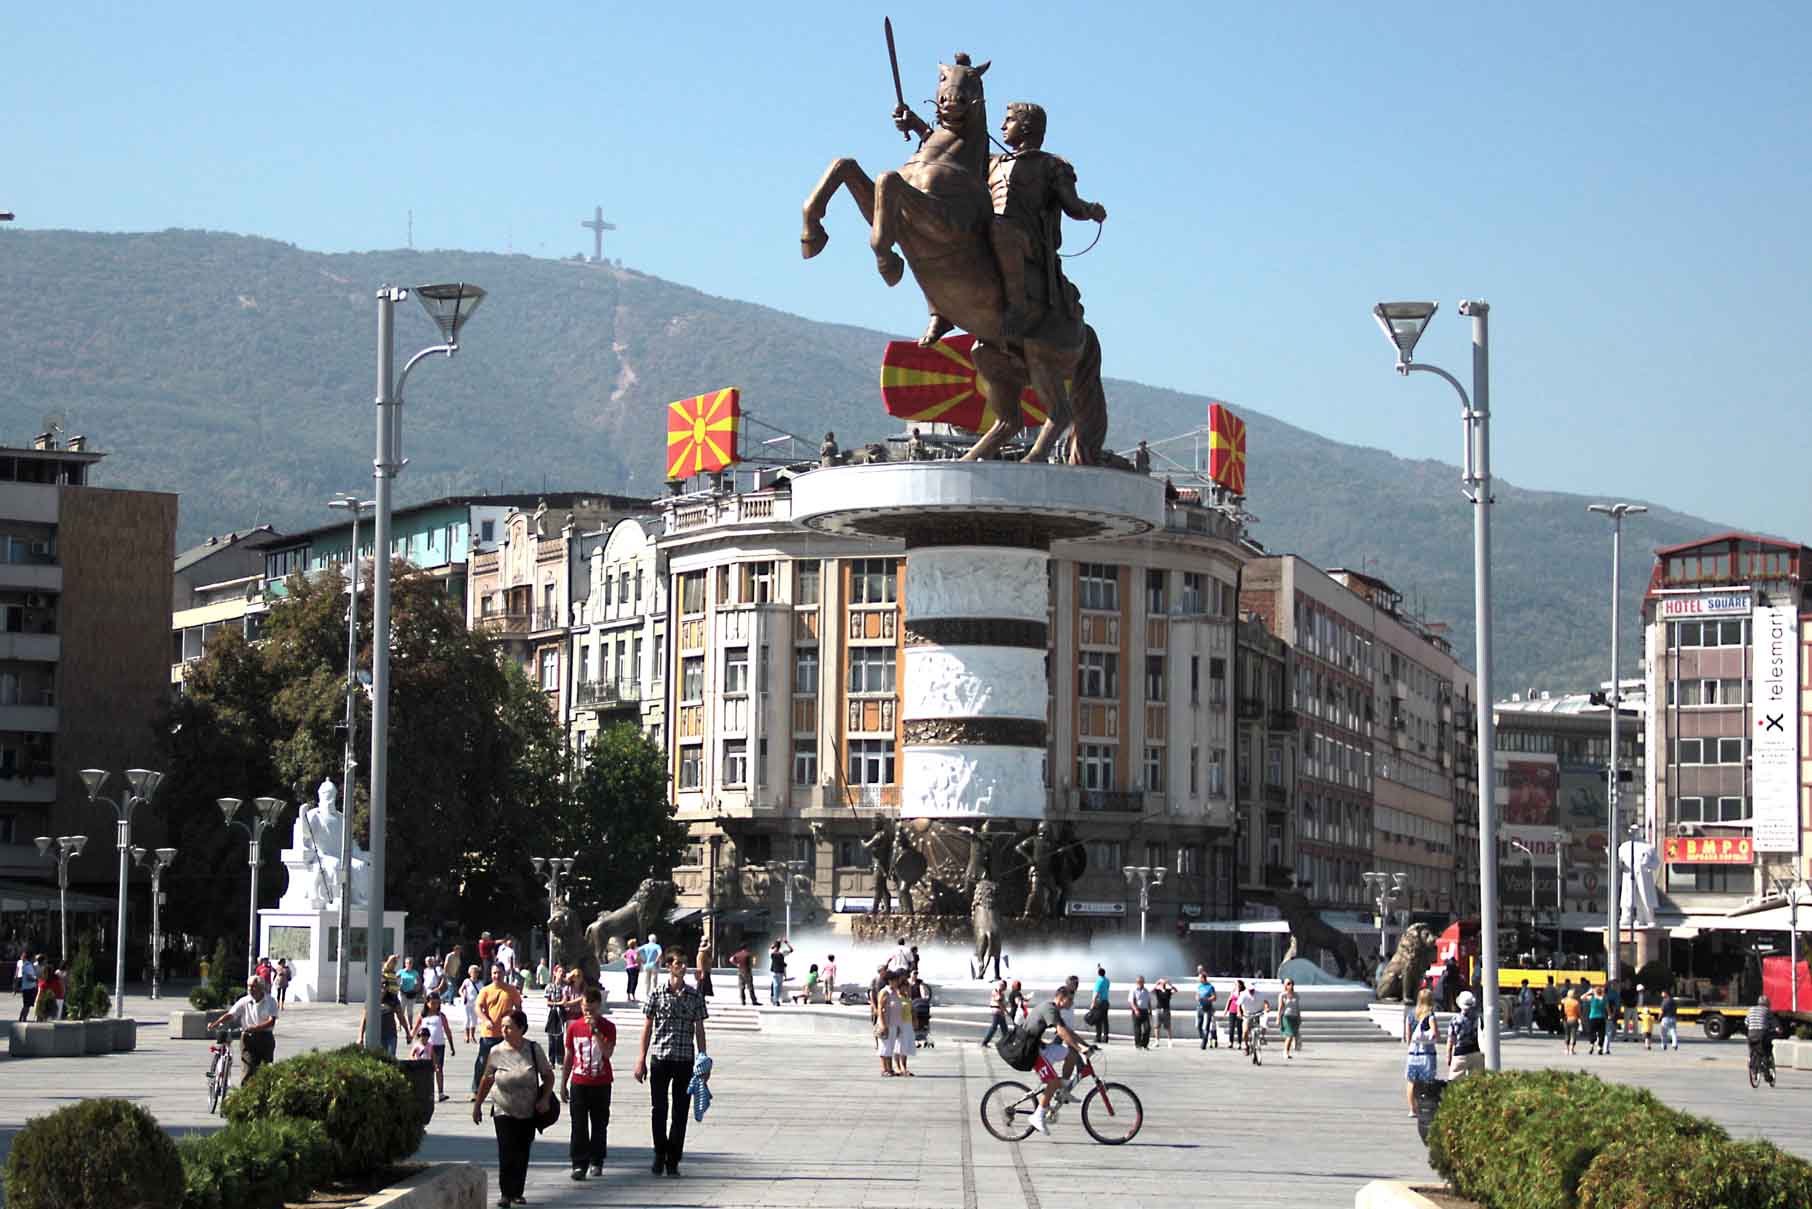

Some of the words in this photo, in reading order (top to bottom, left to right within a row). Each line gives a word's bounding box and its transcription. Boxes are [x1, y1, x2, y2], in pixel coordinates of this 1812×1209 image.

[1665, 599, 1703, 614] HOTEL
[1708, 597, 1746, 609] SQUARE
[1764, 612, 1784, 701] telesmart
